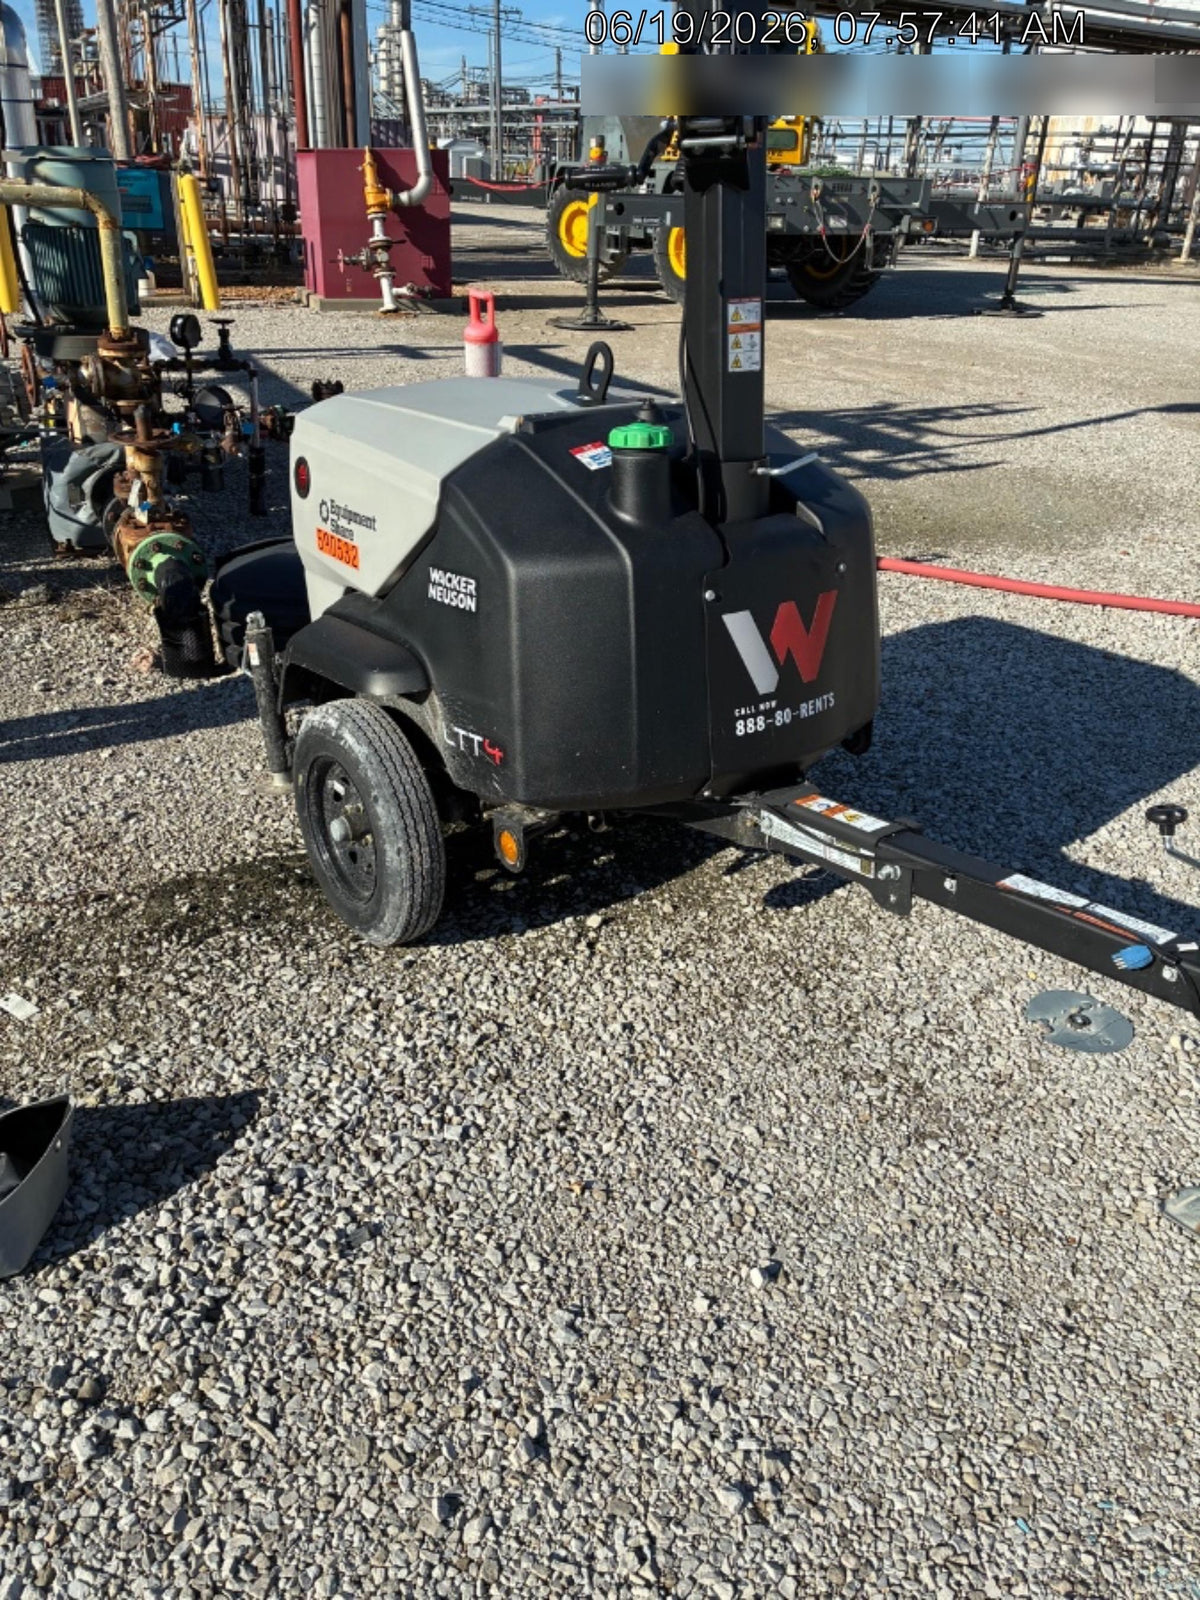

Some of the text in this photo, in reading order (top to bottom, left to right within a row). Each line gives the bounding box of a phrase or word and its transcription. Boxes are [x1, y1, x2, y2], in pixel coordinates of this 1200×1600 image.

[330, 498, 377, 532] Equipment
[330, 518, 354, 541] Share
[428, 566, 477, 597] WACKER
[428, 582, 477, 613] NEUSON
[734, 700, 777, 717] CALL NOW
[735, 692, 835, 736] 888-80-RENTS
[442, 721, 504, 767] LTT4
